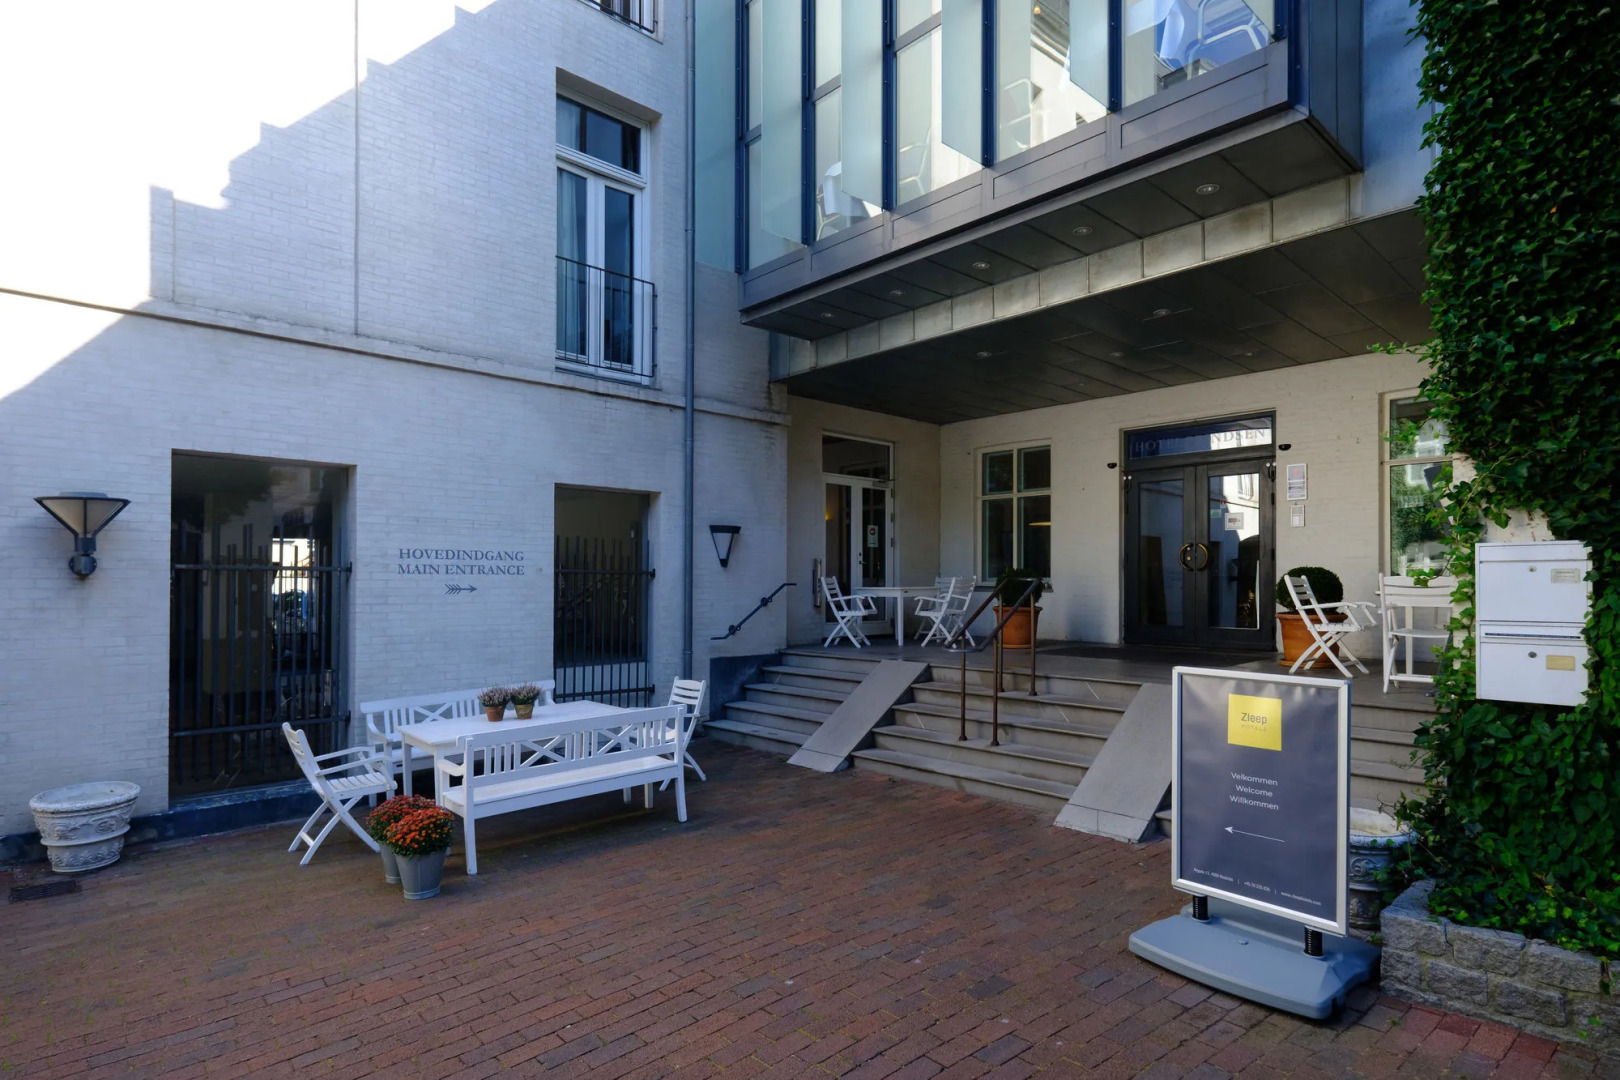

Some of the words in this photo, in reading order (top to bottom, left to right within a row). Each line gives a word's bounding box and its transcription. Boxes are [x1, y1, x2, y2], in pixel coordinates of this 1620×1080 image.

[399, 548, 524, 561] HOVEDINDGANG
[398, 564, 440, 575] MAIN
[445, 564, 525, 576] ENTRANCE
[1240, 712, 1268, 725] Zleep
[1230, 771, 1278, 786] Velkommen
[1235, 784, 1273, 797] Welcome
[1229, 795, 1279, 810] Willkommen
